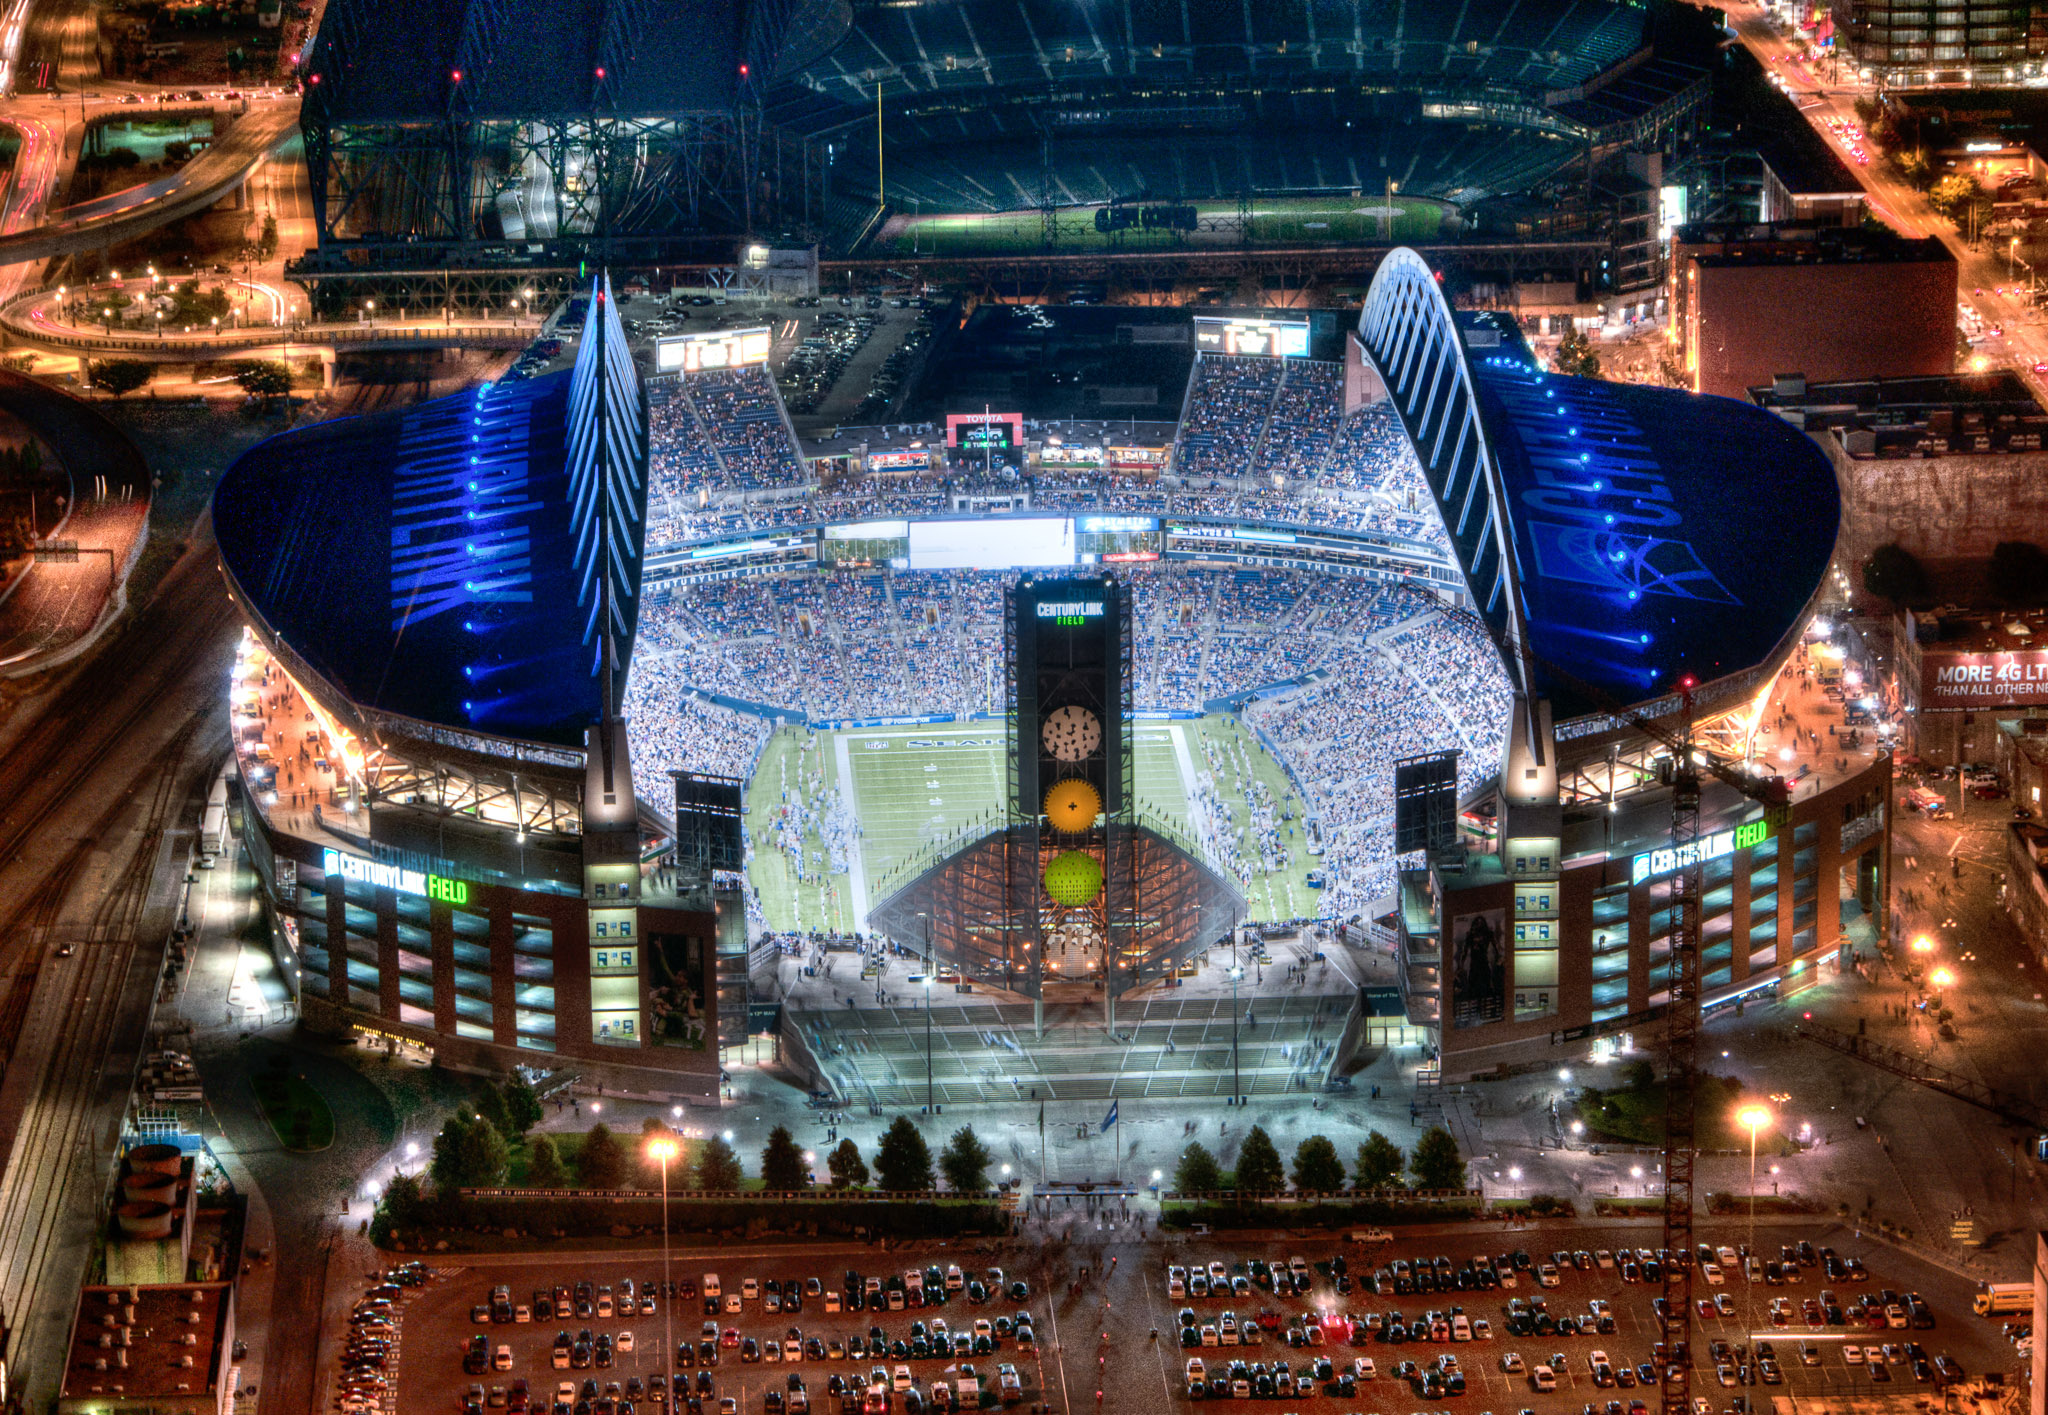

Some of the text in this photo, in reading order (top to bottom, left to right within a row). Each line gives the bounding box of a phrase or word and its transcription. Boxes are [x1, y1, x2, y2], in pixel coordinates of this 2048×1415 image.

[966, 415, 1003, 423] TOYOTA
[647, 565, 786, 592] CENTURYLINK FIELD
[1237, 556, 1403, 582] HOME OF THE 12TH MAN
[1037, 602, 1104, 616] CENTURYLINK
[1057, 616, 1085, 626] FIELD
[1937, 663, 2048, 683] MORE 4G LT
[1936, 685, 1968, 697] THAN
[1970, 684, 1992, 696] ALL
[1995, 683, 2034, 695] OTHER
[1736, 820, 1767, 850] FIELD
[339, 852, 427, 896] CENTURYLINK
[428, 874, 467, 904] FIELD
